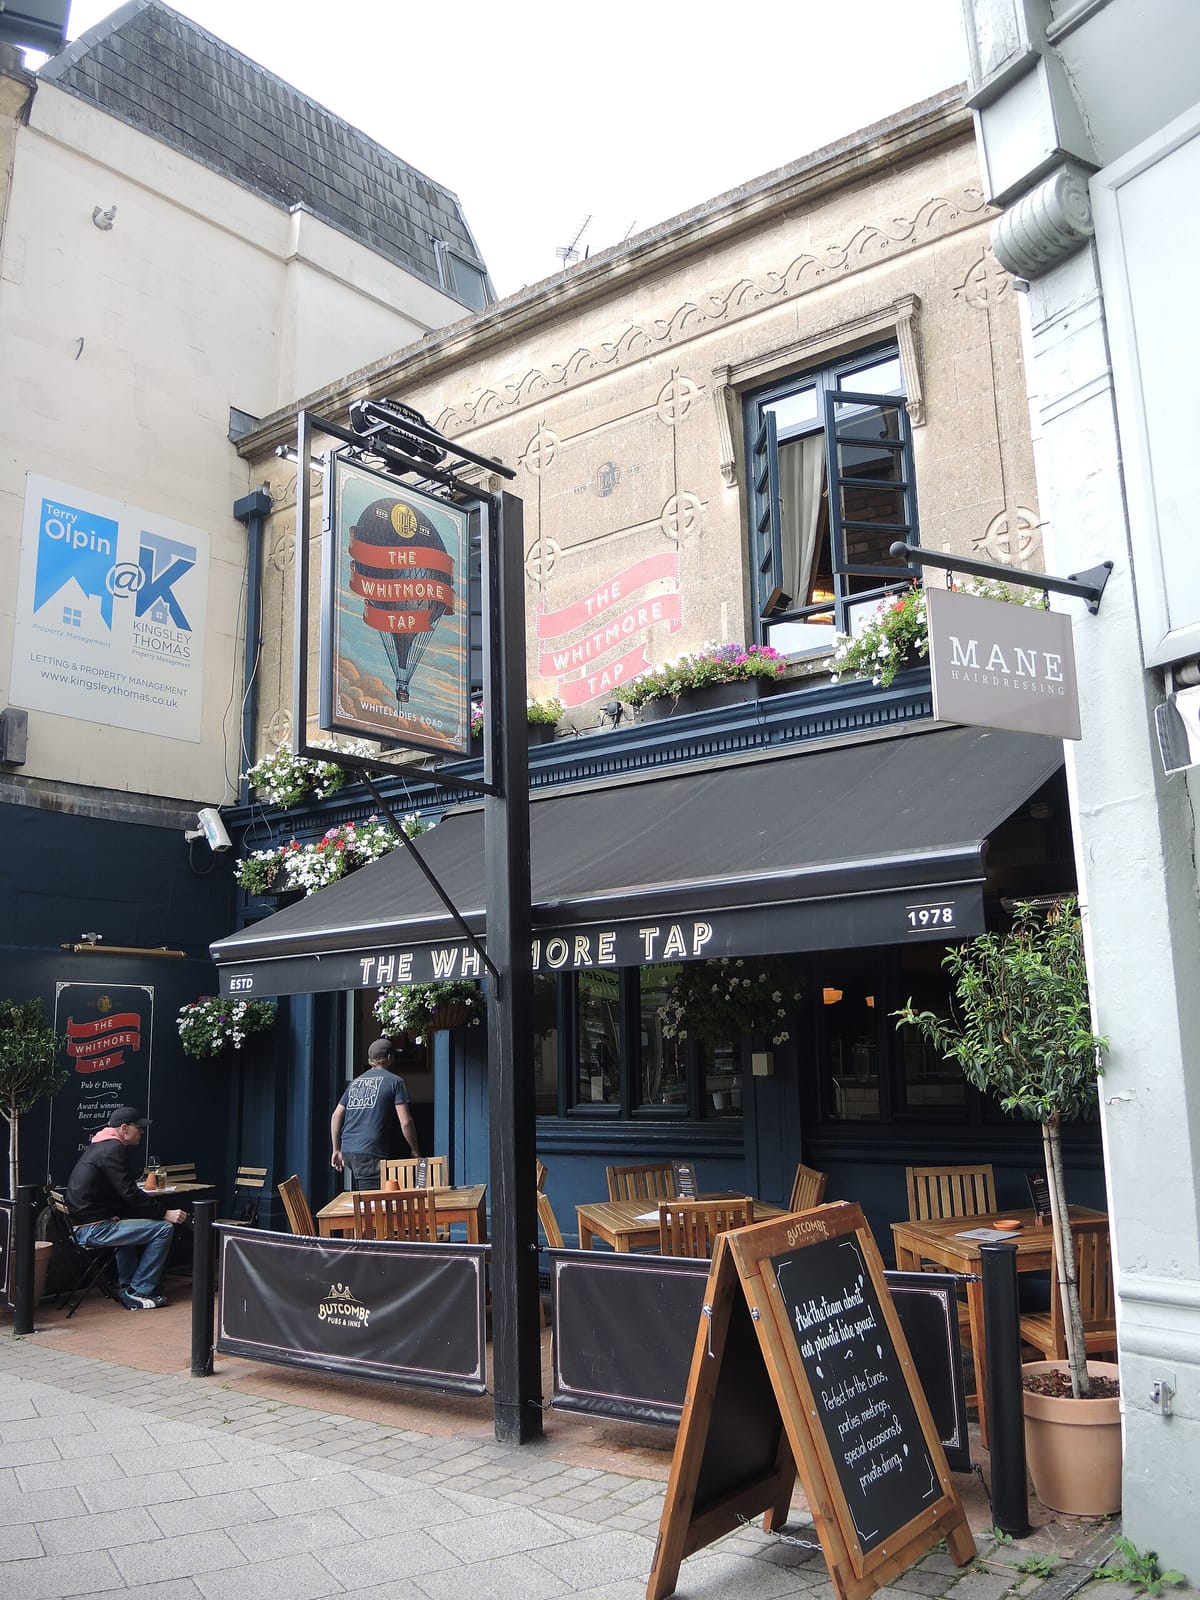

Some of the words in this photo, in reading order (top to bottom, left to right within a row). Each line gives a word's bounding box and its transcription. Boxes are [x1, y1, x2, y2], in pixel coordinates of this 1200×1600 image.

[46, 504, 78, 523] Terry
[45, 518, 111, 555] Olpin
[388, 551, 417, 565] THE
[361, 579, 444, 600] WHITMORE
[584, 581, 621, 616] THE
[133, 619, 191, 645] KINGSLEY
[387, 615, 416, 630] TAP
[32, 623, 65, 637] Property
[66, 632, 112, 649] Management
[132, 633, 191, 658] THOMAS
[552, 602, 663, 670] WHITMORE
[949, 636, 1063, 682] MANE
[30, 653, 70, 669] LETTING
[71, 662, 78, 671] &
[80, 664, 127, 682] PROPERTY
[128, 677, 189, 697] MANAGEMENT
[587, 663, 624, 694] TAP
[951, 670, 1065, 696] HAIRDRESSING
[40, 670, 178, 708] www.kingsleythomas.co.uk
[360, 701, 417, 722] WHITELADIES
[420, 716, 443, 728] ROAD
[907, 907, 953, 926] 1978
[360, 952, 414, 985] THE
[639, 922, 713, 960] TAP
[230, 978, 253, 990] ESTD
[94, 1019, 113, 1031] THE
[75, 1034, 131, 1053] WHITMORE
[92, 1058, 111, 1069] TAP
[81, 1081, 94, 1089] Pub
[102, 1081, 122, 1090] Dining
[77, 1100, 99, 1110] Award
[78, 1111, 93, 1119] Beer
[93, 1111, 106, 1119] and
[787, 1220, 834, 1247] BUTCOMBE
[317, 1303, 370, 1328] BUTCOMBE
[795, 1302, 814, 1332] Ask
[809, 1299, 826, 1323] the
[821, 1295, 844, 1318] team
[843, 1282, 864, 1310] about
[327, 1316, 342, 1325] PUBS
[801, 1339, 816, 1359] our
[814, 1322, 841, 1361] private
[836, 1319, 855, 1342] hire
[854, 1304, 877, 1341] space!
[821, 1382, 848, 1412] Perfect
[844, 1379, 856, 1399] for
[852, 1374, 867, 1394] the
[844, 1433, 868, 1469] special
[866, 1424, 897, 1451] occasions
[892, 1414, 903, 1435] &
[859, 1458, 883, 1497] private
